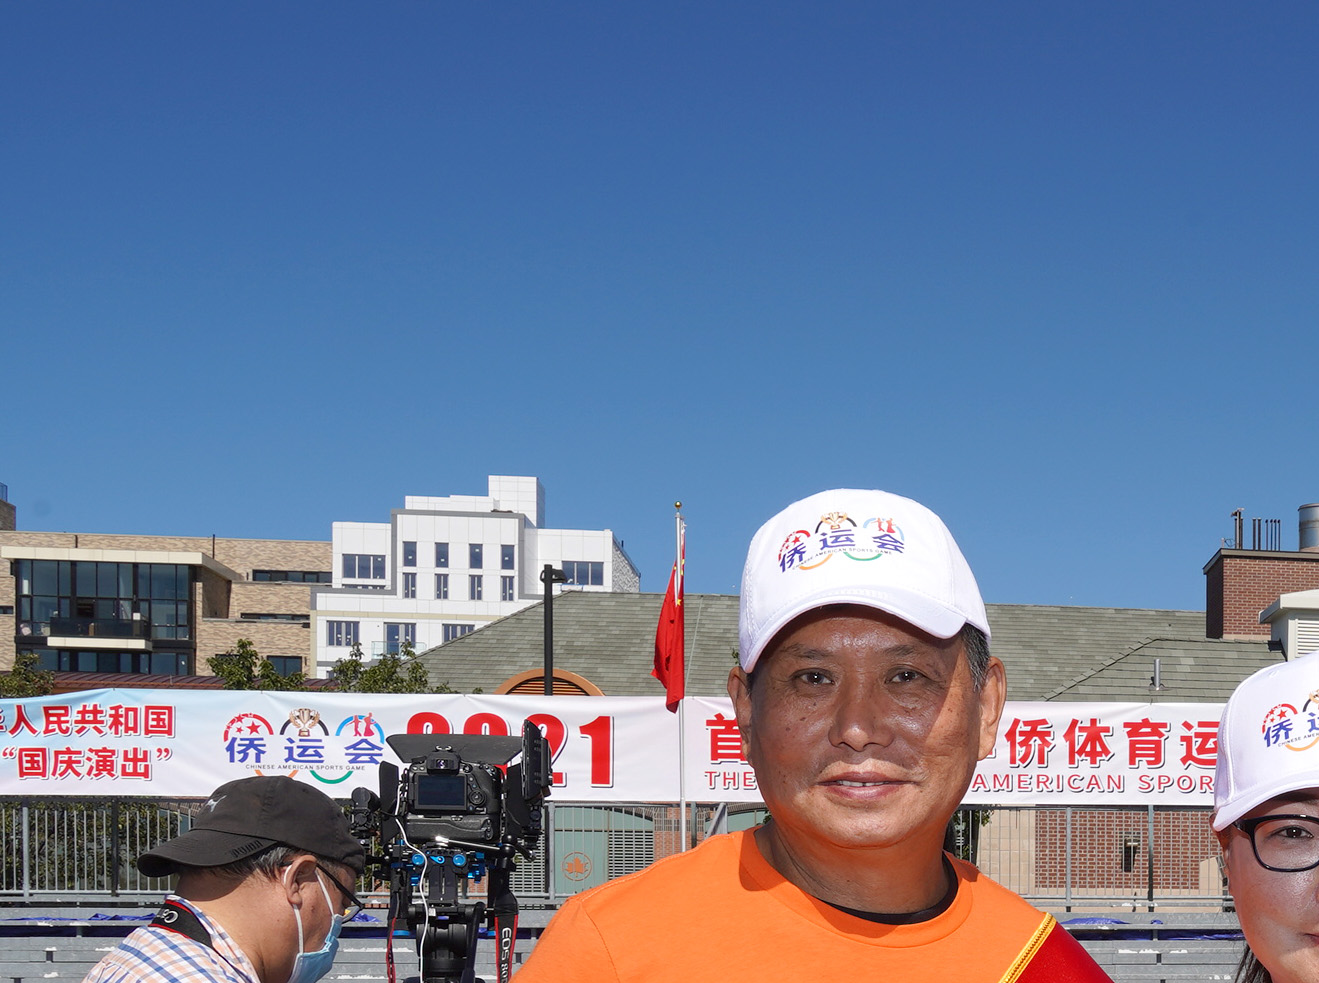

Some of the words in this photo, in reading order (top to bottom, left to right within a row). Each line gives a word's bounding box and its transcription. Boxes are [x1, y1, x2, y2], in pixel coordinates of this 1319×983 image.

[779, 529, 905, 573] 侨运会
[815, 547, 847, 557] AMERICAN
[0, 703, 176, 738] 人民共和国
[225, 736, 385, 765] 侨运会
[990, 717, 1219, 769] 侨体育运
[1277, 736, 1301, 747] CHINESE
[704, 771, 757, 790] THE
[971, 773, 1125, 792] AMERICAN
[501, 927, 512, 961] EOS
